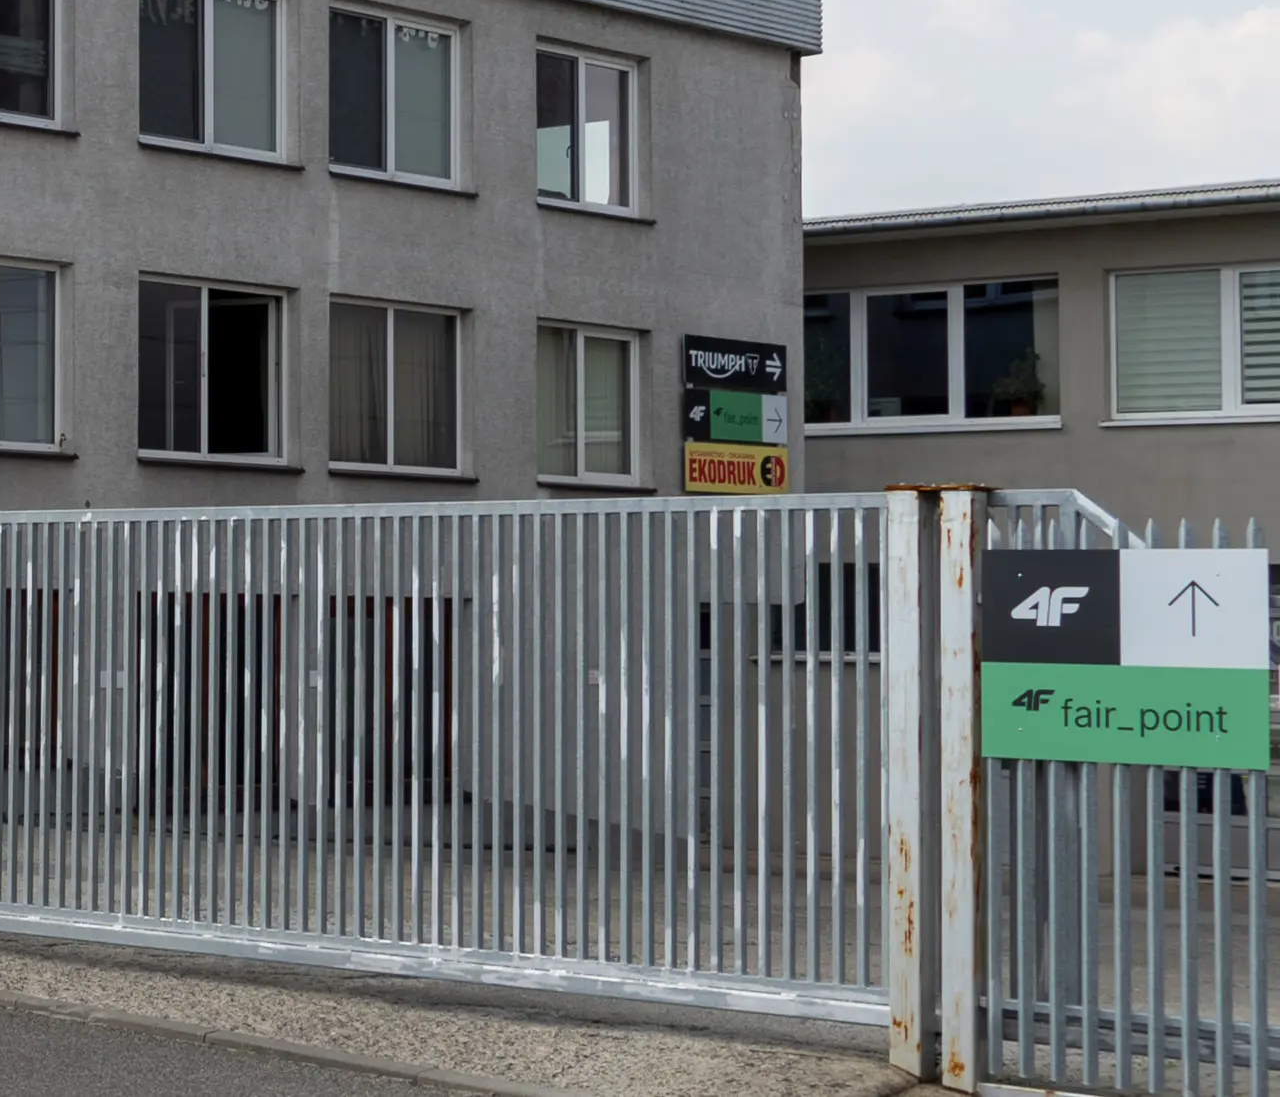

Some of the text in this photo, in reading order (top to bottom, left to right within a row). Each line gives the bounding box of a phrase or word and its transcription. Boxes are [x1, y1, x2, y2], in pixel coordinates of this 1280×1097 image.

[688, 349, 746, 378] TRIUMPH
[688, 405, 706, 421] 4F
[688, 458, 757, 486] EKODRUK
[1010, 586, 1090, 627] 4F
[1011, 688, 1229, 738] 4F fair_point
